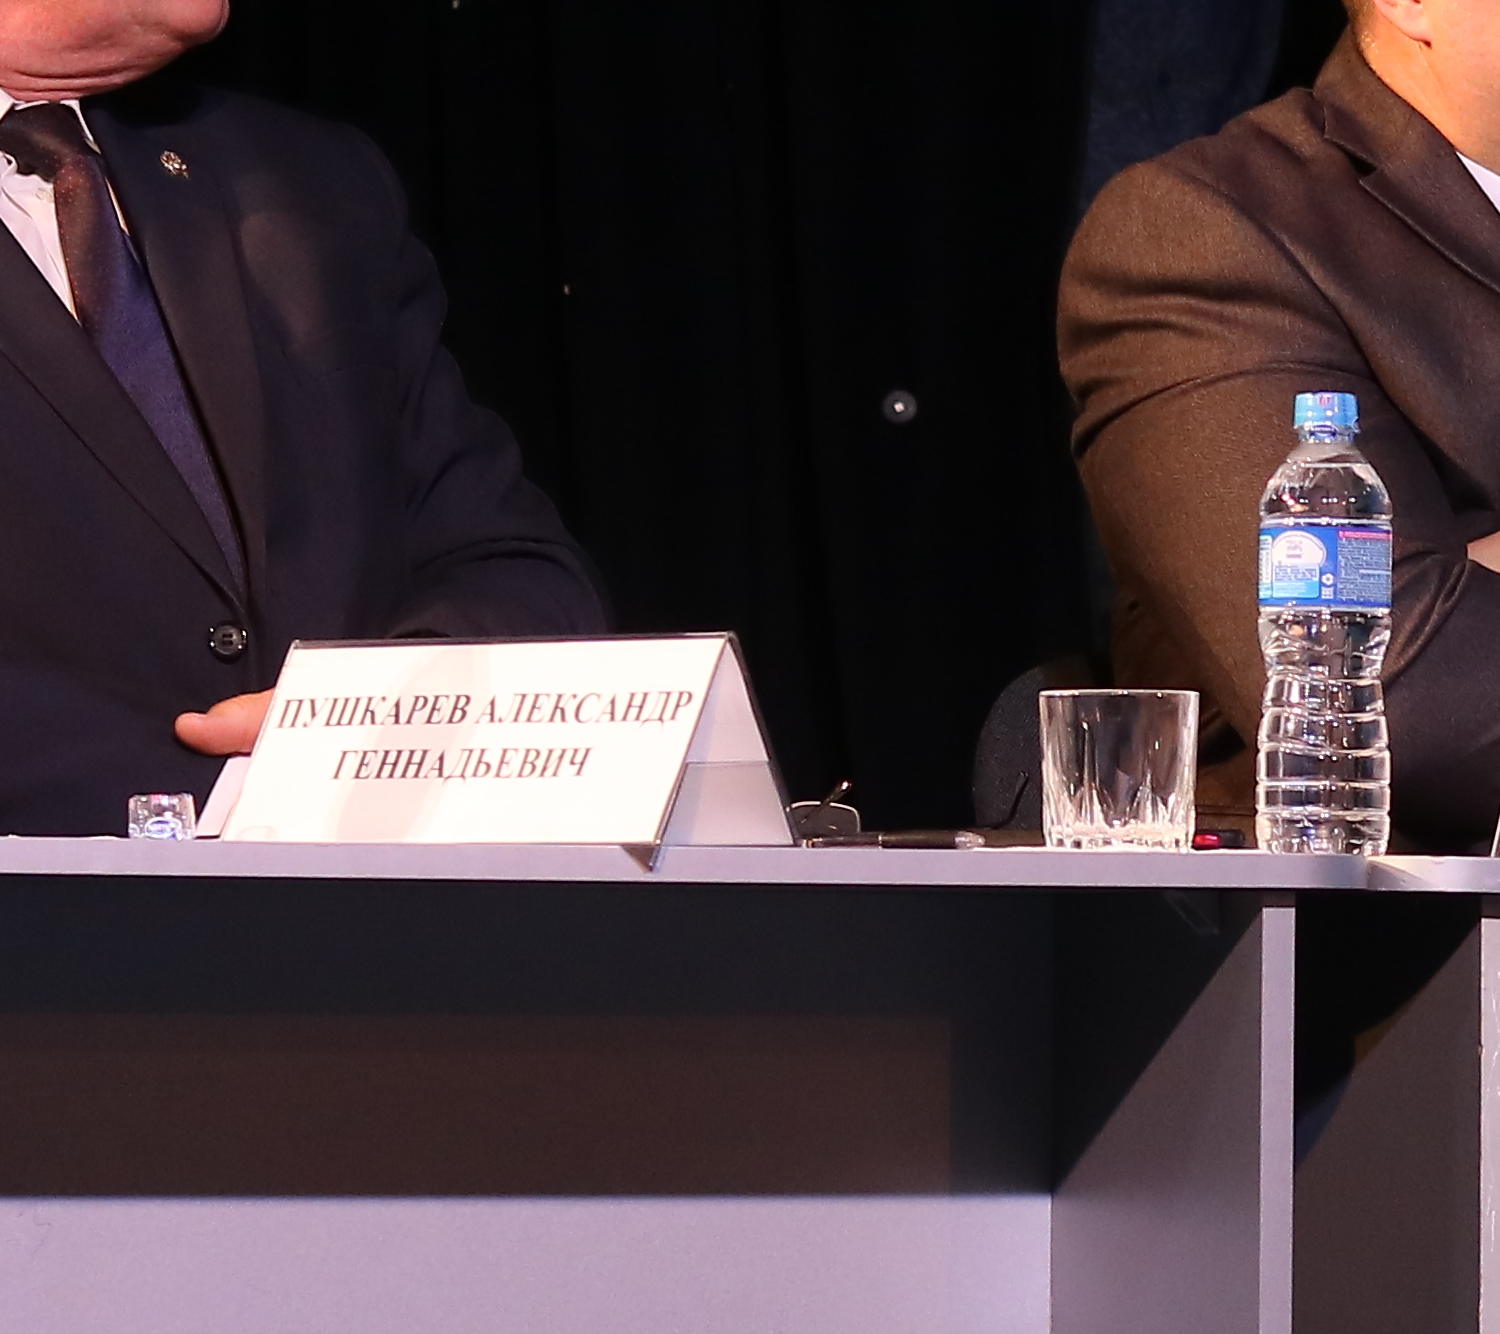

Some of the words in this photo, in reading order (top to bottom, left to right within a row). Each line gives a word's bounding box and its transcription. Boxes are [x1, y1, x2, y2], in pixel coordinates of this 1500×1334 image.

[277, 693, 471, 729] ПУШКАРЕВ
[475, 691, 694, 727] АЛЕКСАНДР
[332, 747, 593, 784] ГЕННАДЬЕВИЧ
